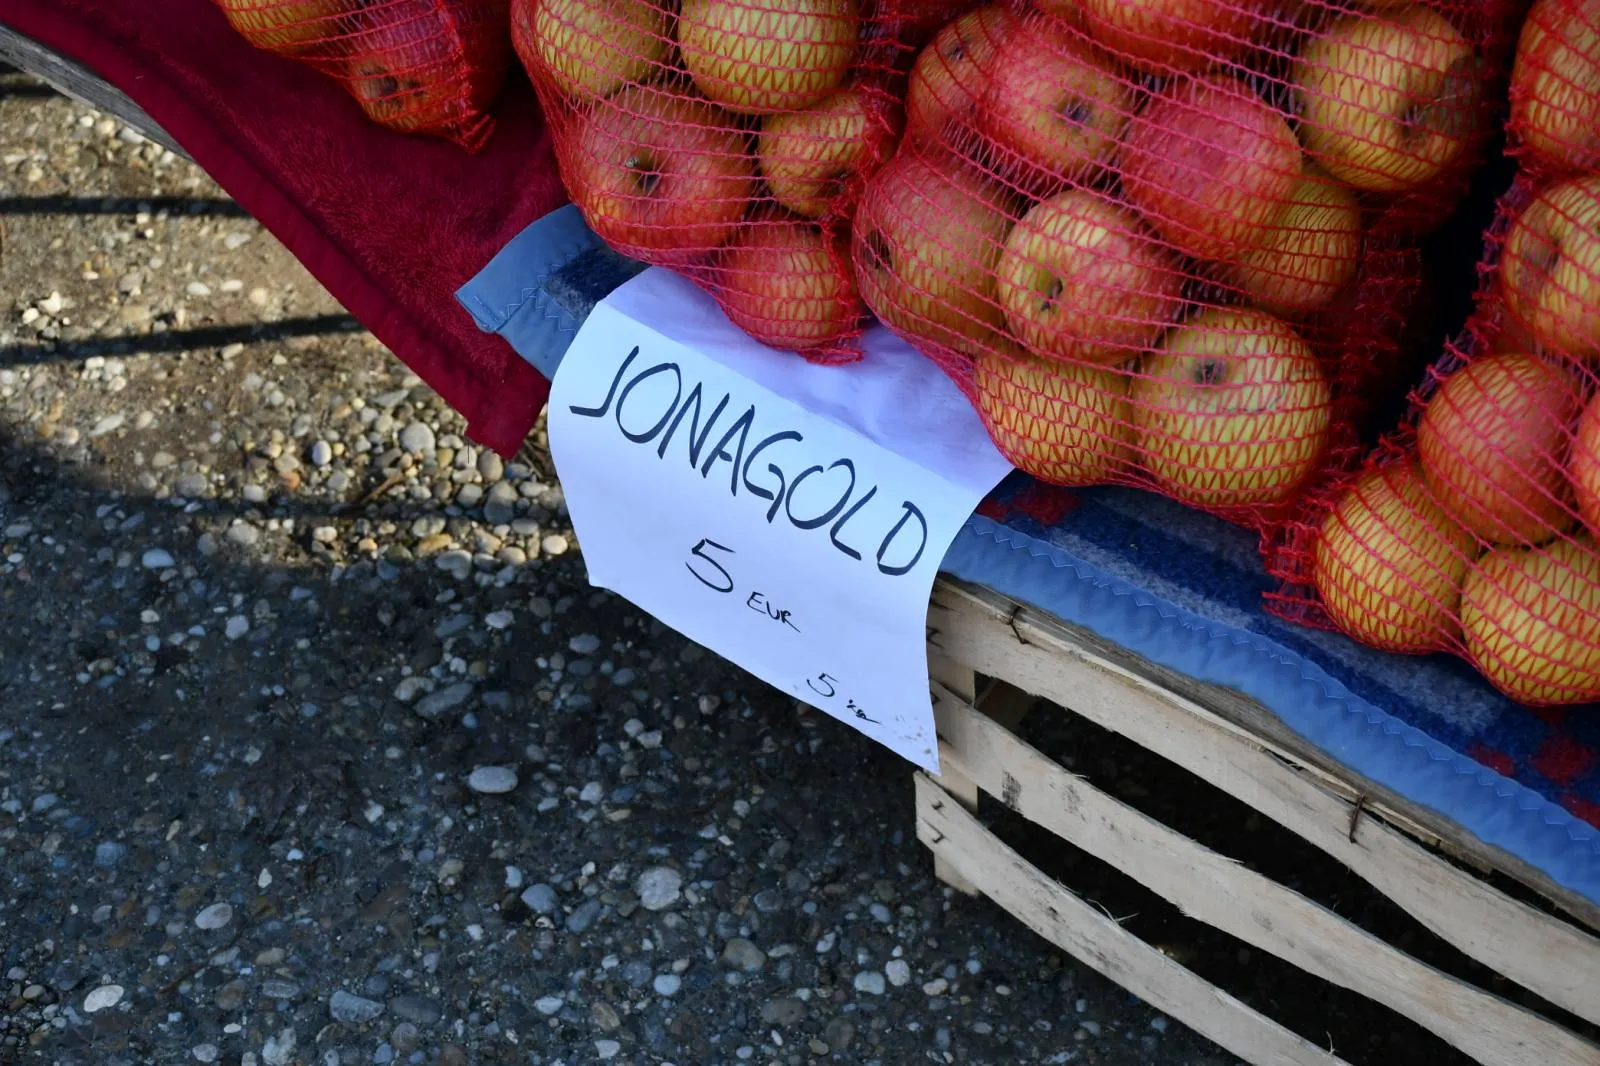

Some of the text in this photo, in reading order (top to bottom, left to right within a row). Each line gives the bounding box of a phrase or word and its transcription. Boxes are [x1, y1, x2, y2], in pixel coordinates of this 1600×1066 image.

[569, 345, 928, 576] JONAGOLD
[685, 538, 801, 633] 5 EUR
[806, 672, 839, 697] 5
